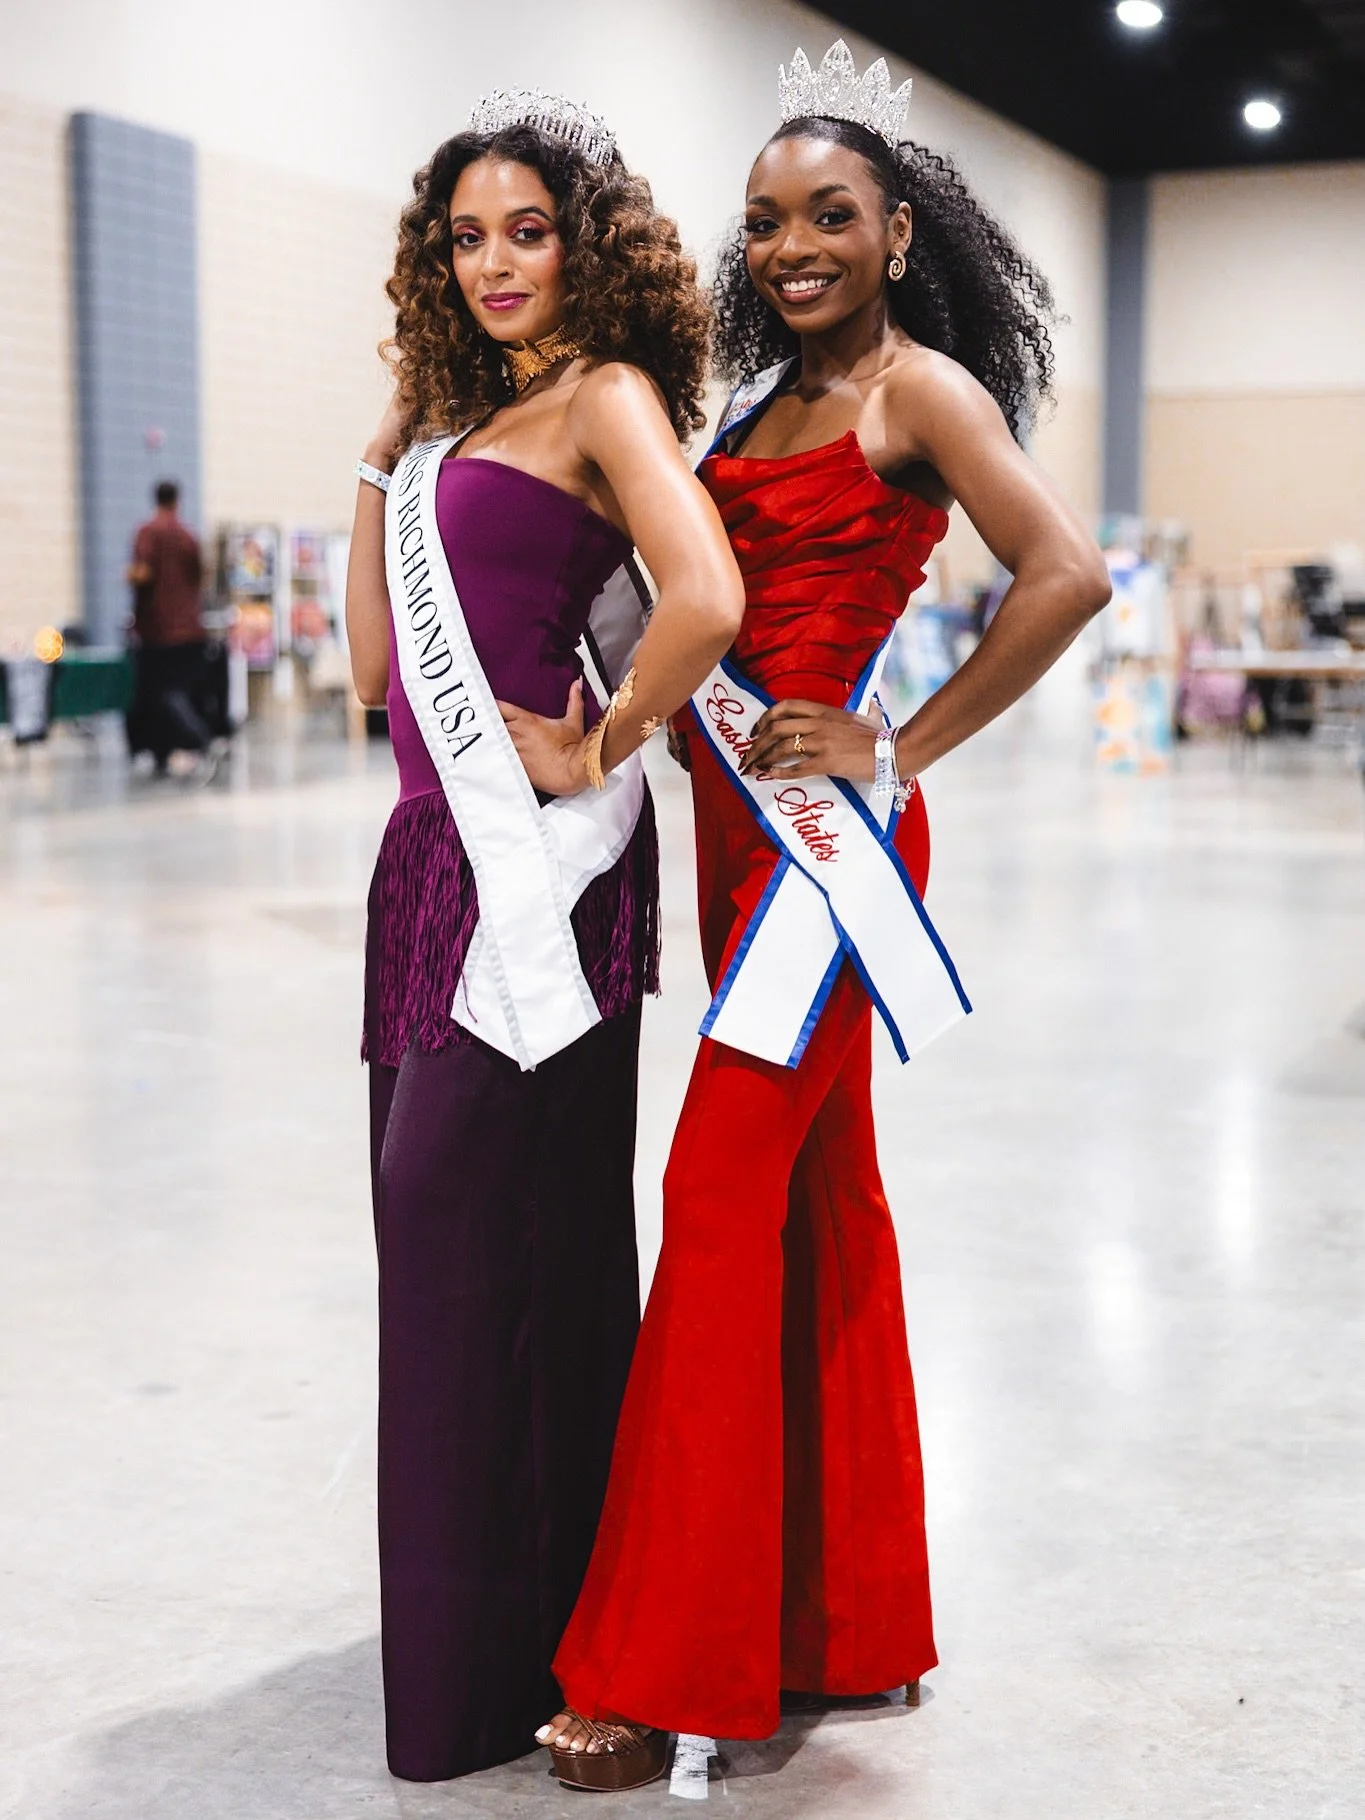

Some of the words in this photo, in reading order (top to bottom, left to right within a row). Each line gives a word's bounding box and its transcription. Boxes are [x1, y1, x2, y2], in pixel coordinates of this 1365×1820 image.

[397, 490, 454, 681] RICHMOND
[432, 681, 484, 761] USA
[774, 787, 840, 863] States
